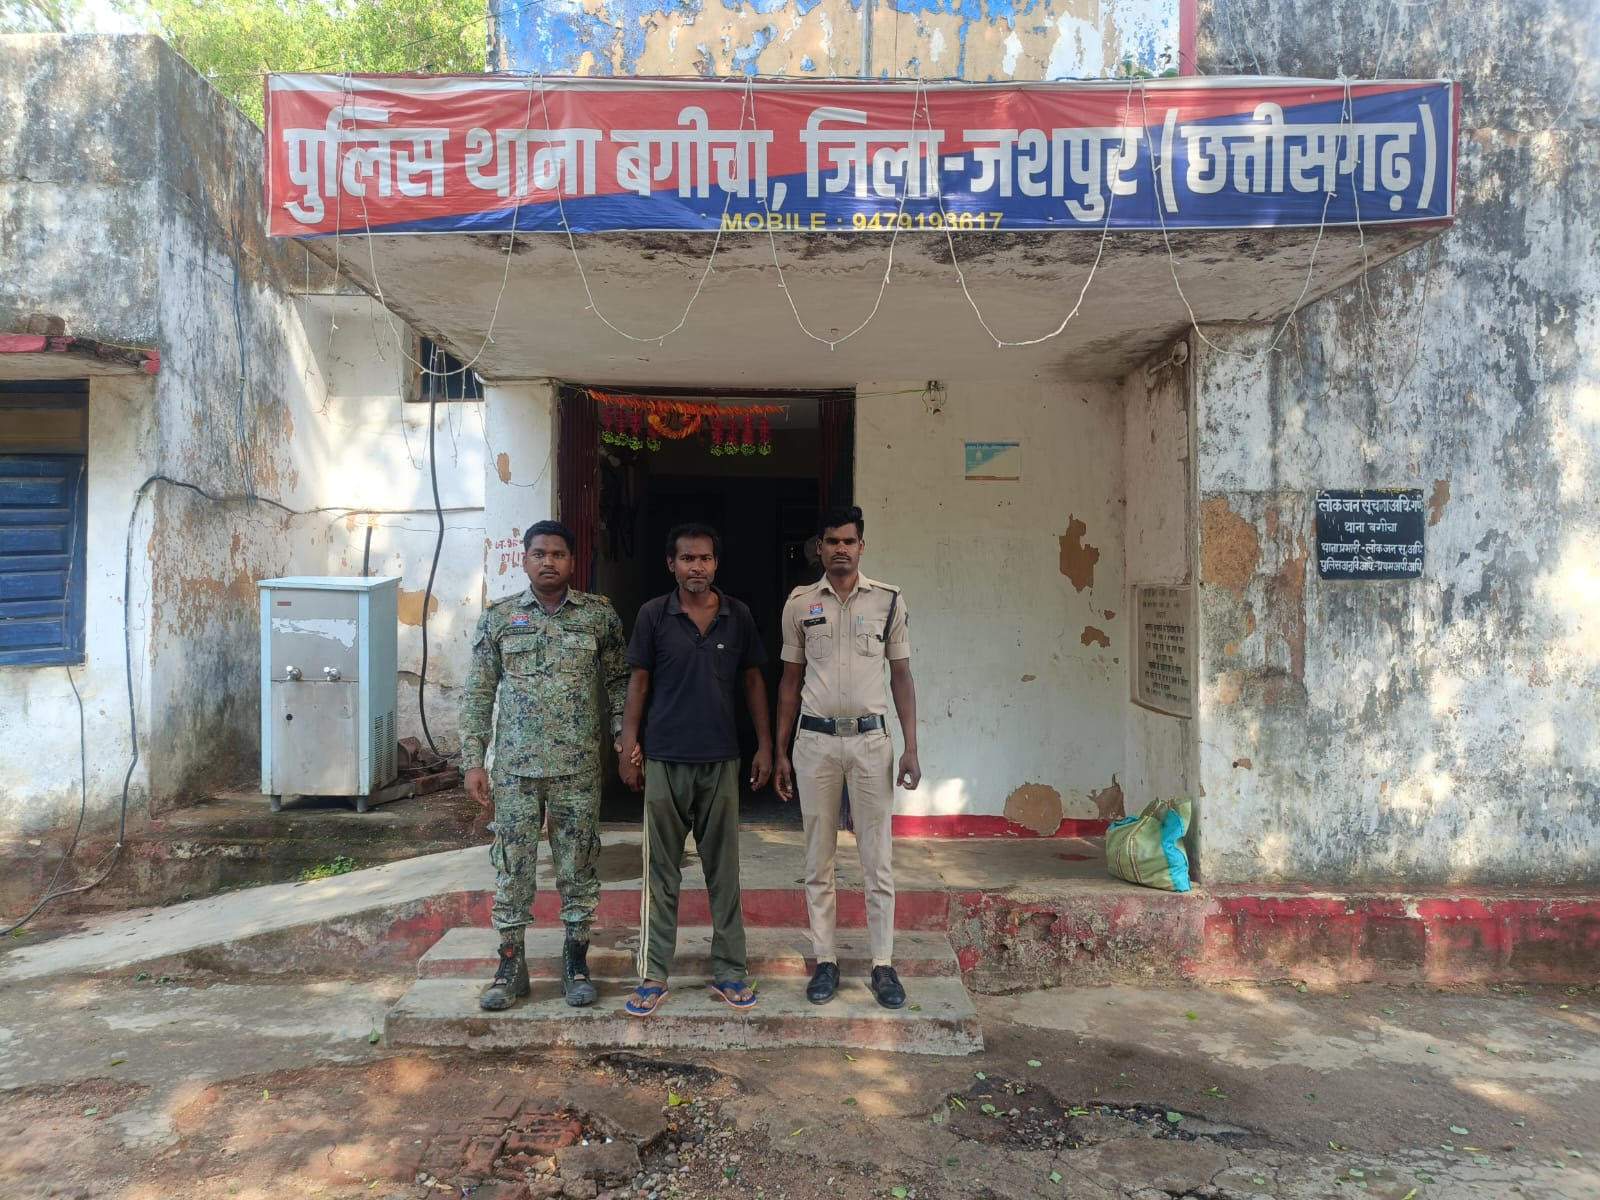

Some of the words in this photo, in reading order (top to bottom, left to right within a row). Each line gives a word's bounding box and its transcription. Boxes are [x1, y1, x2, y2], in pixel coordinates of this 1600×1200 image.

[283, 106, 450, 224] पुलिस
[465, 127, 602, 197] थाना
[610, 106, 788, 211] बगीचा,
[1160, 102, 1437, 213] (छत्तीसगढ़)
[721, 212, 827, 231] MOBILE
[851, 211, 1004, 231] 9479193617
[1317, 493, 1342, 512] लोक
[1342, 499, 1360, 512] जन
[1361, 498, 1389, 516] सूचना
[1344, 522, 1365, 533] थाना
[1367, 517, 1398, 533] बगीचा
[1365, 539, 1383, 554] लोक
[1320, 556, 1341, 573] पुलिस
